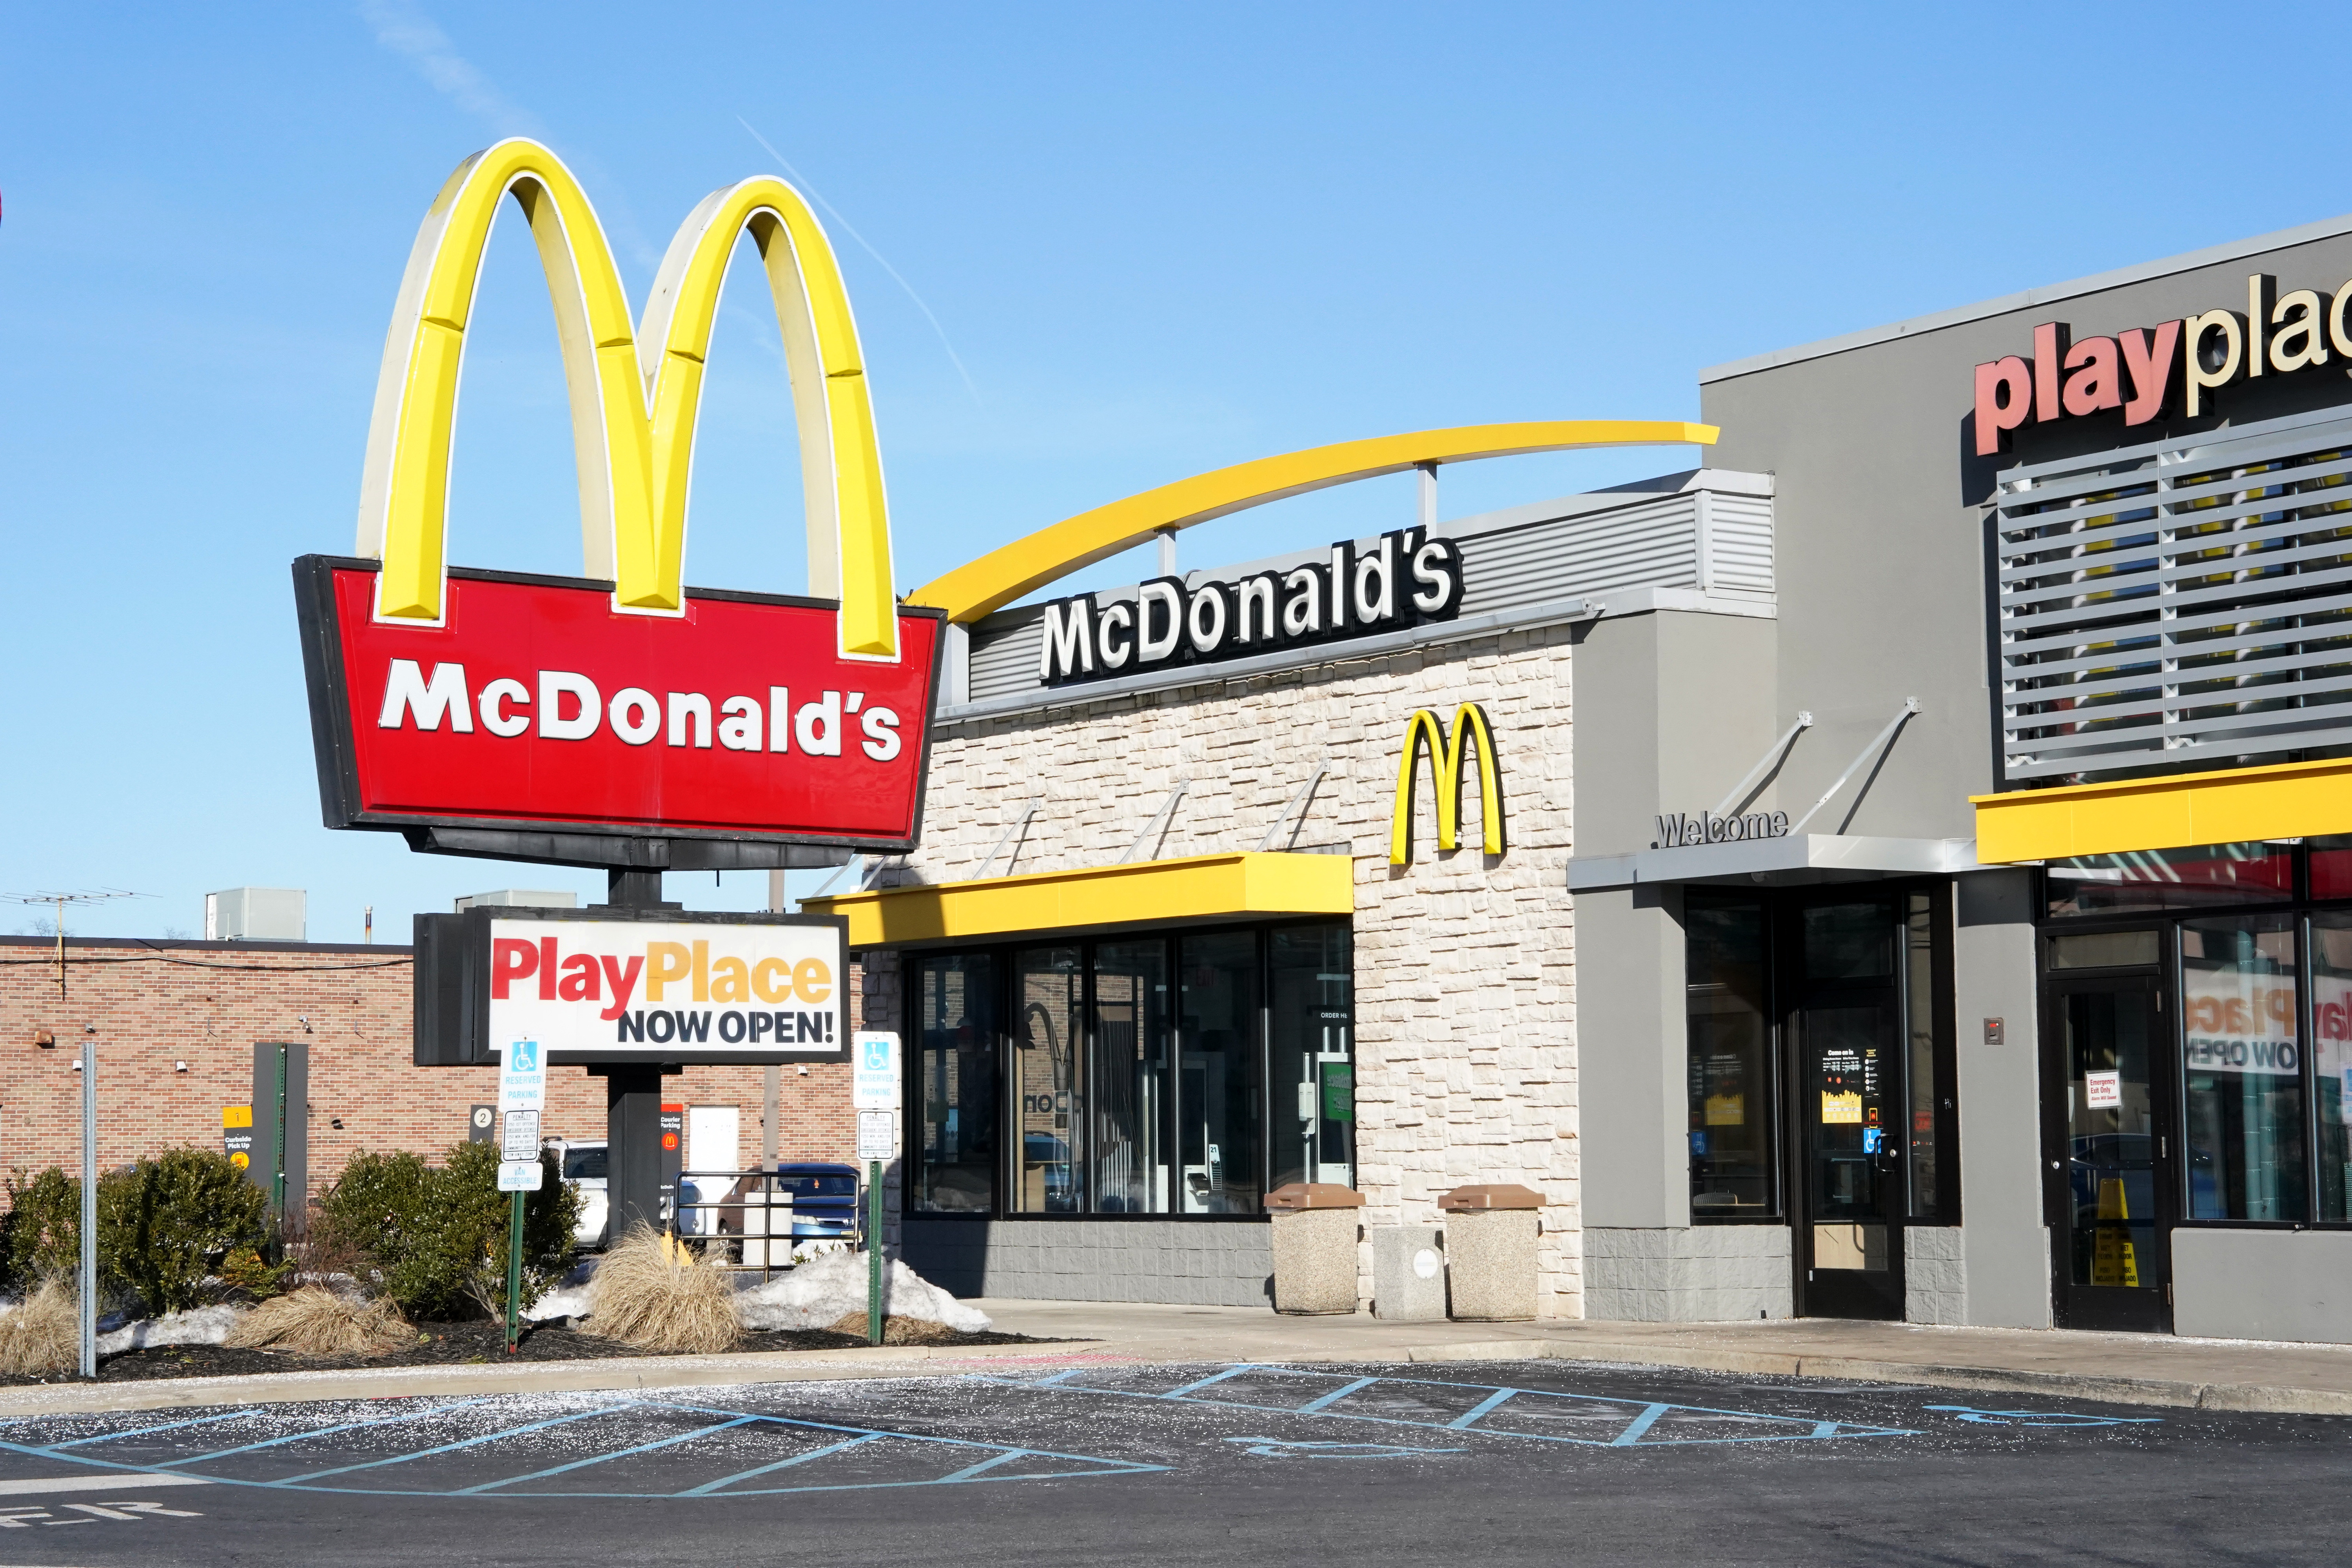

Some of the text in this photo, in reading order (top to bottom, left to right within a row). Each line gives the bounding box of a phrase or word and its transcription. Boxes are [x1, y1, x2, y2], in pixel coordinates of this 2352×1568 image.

[1040, 532, 1452, 679] McDonald's
[379, 658, 902, 761] McDonald's
[1655, 811, 1788, 848] Welcome
[492, 937, 831, 1020] PlayPlace
[618, 1010, 834, 1043] NOW OPEN!
[506, 1076, 541, 1084] RESERVED
[508, 1091, 537, 1099] PARKING
[862, 1088, 891, 1096] PARKING
[236, 1112, 239, 1122] 1
[480, 1113, 486, 1123] 2
